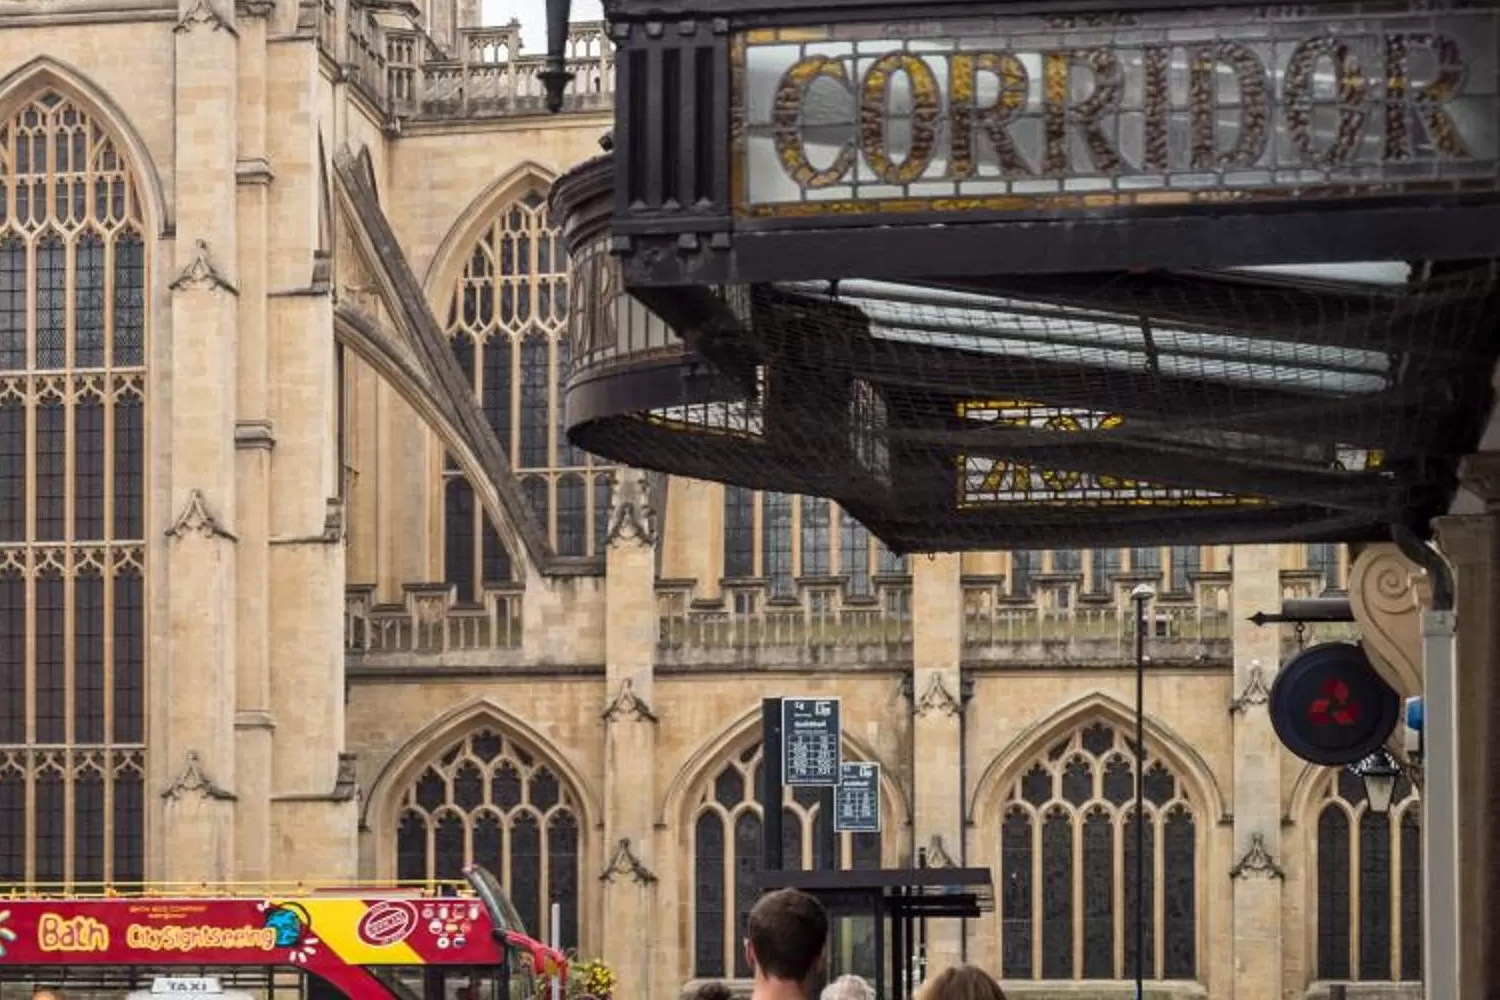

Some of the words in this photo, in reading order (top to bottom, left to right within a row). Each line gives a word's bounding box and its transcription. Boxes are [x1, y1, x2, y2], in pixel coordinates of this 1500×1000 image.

[773, 33, 1475, 190] CORRIDOR
[39, 912, 109, 950] Bath
[169, 982, 207, 991] TAXI
